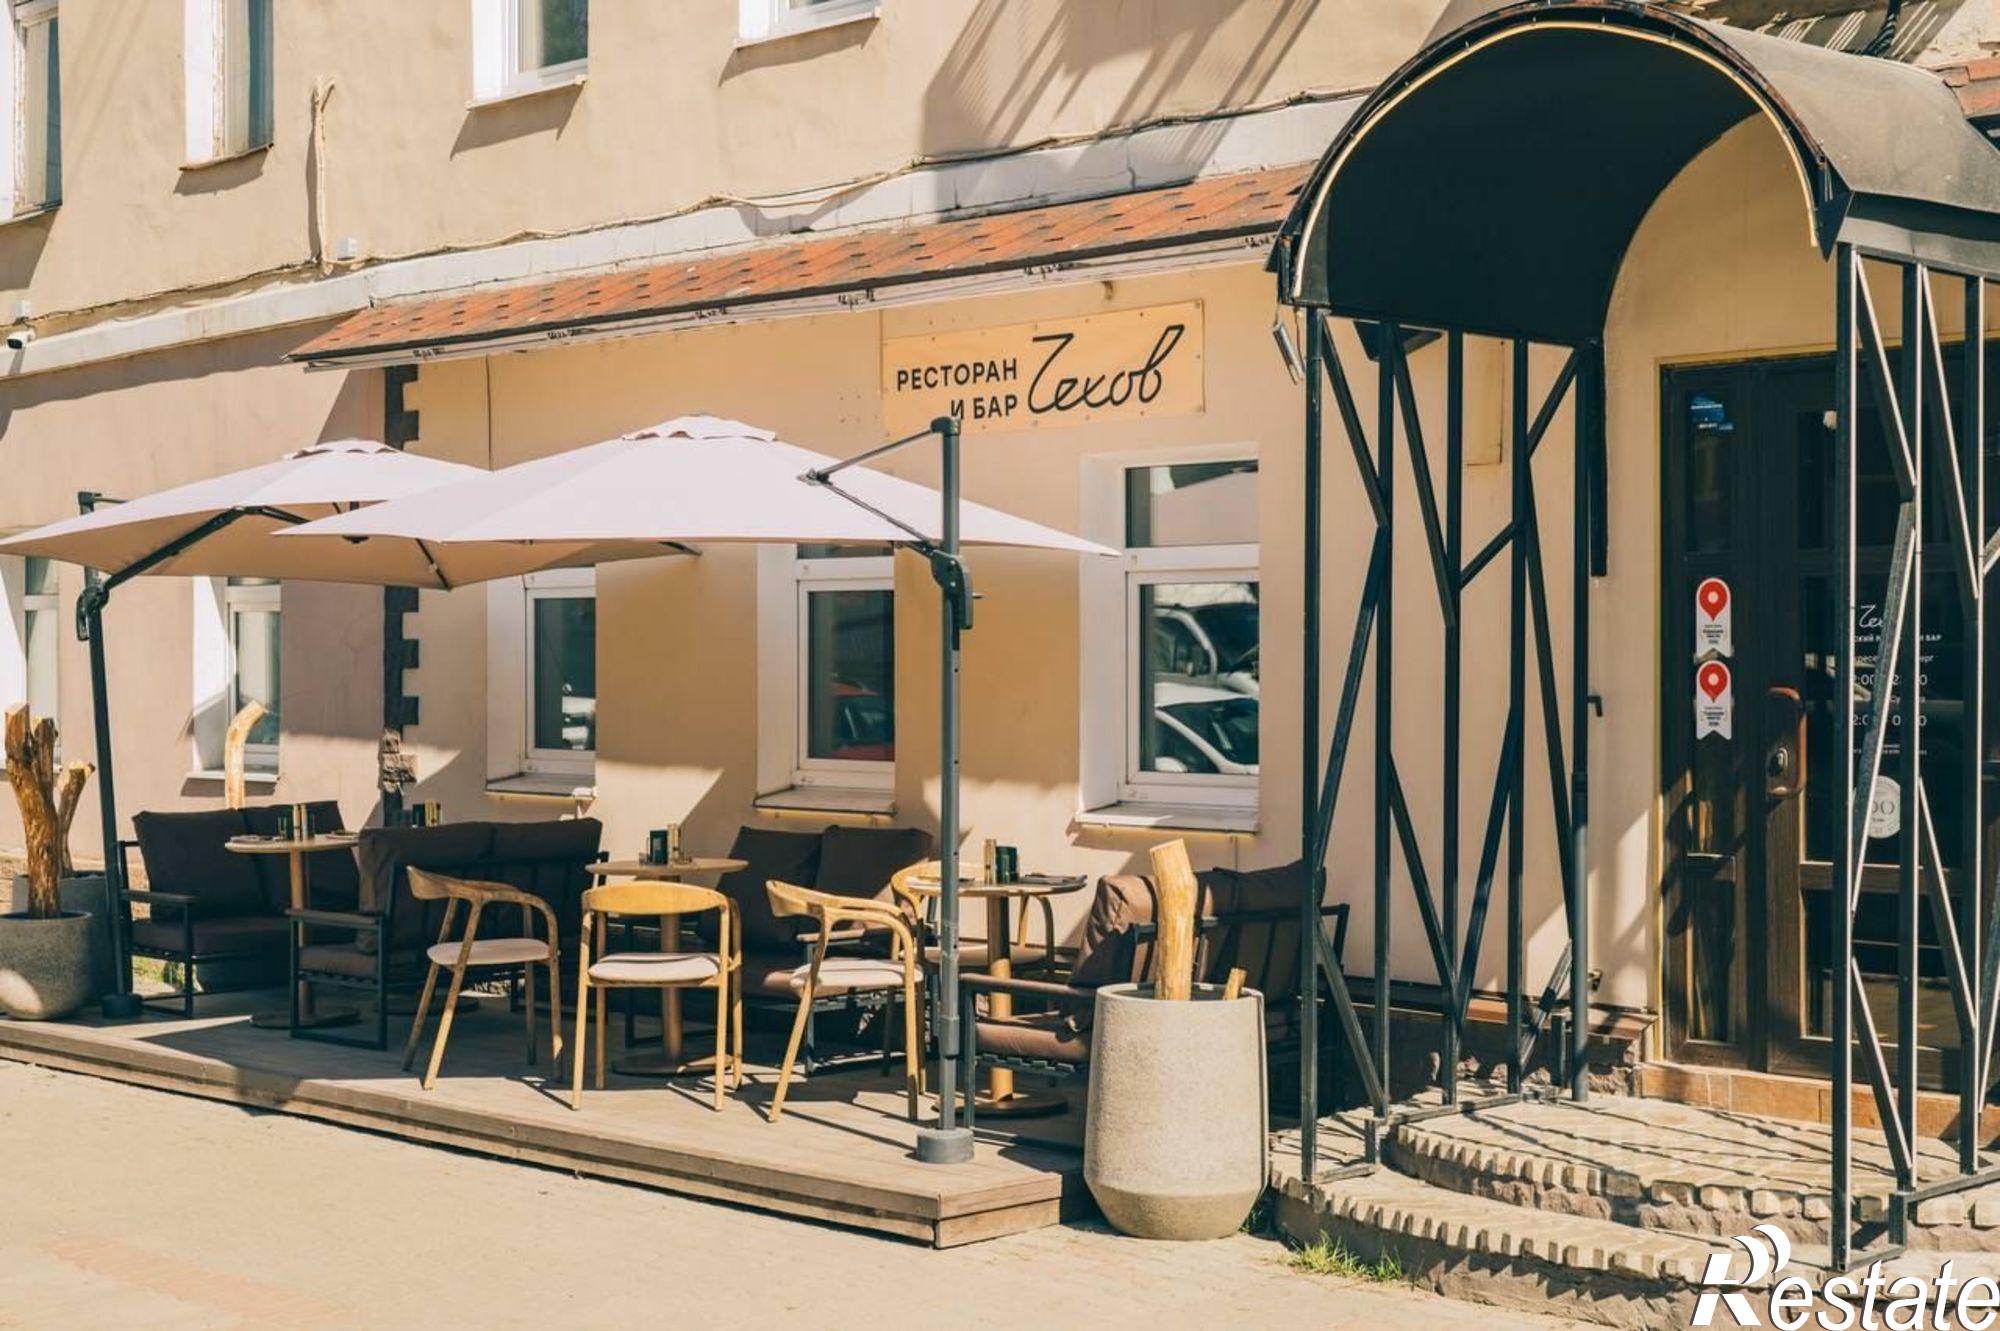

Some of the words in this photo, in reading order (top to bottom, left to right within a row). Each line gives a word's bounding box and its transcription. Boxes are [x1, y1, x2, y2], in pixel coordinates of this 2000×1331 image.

[896, 357, 1018, 392] РЕСТОРАН
[1027, 323, 1186, 415] Чехов
[950, 399, 965, 420] И
[972, 394, 1018, 420] БАР
